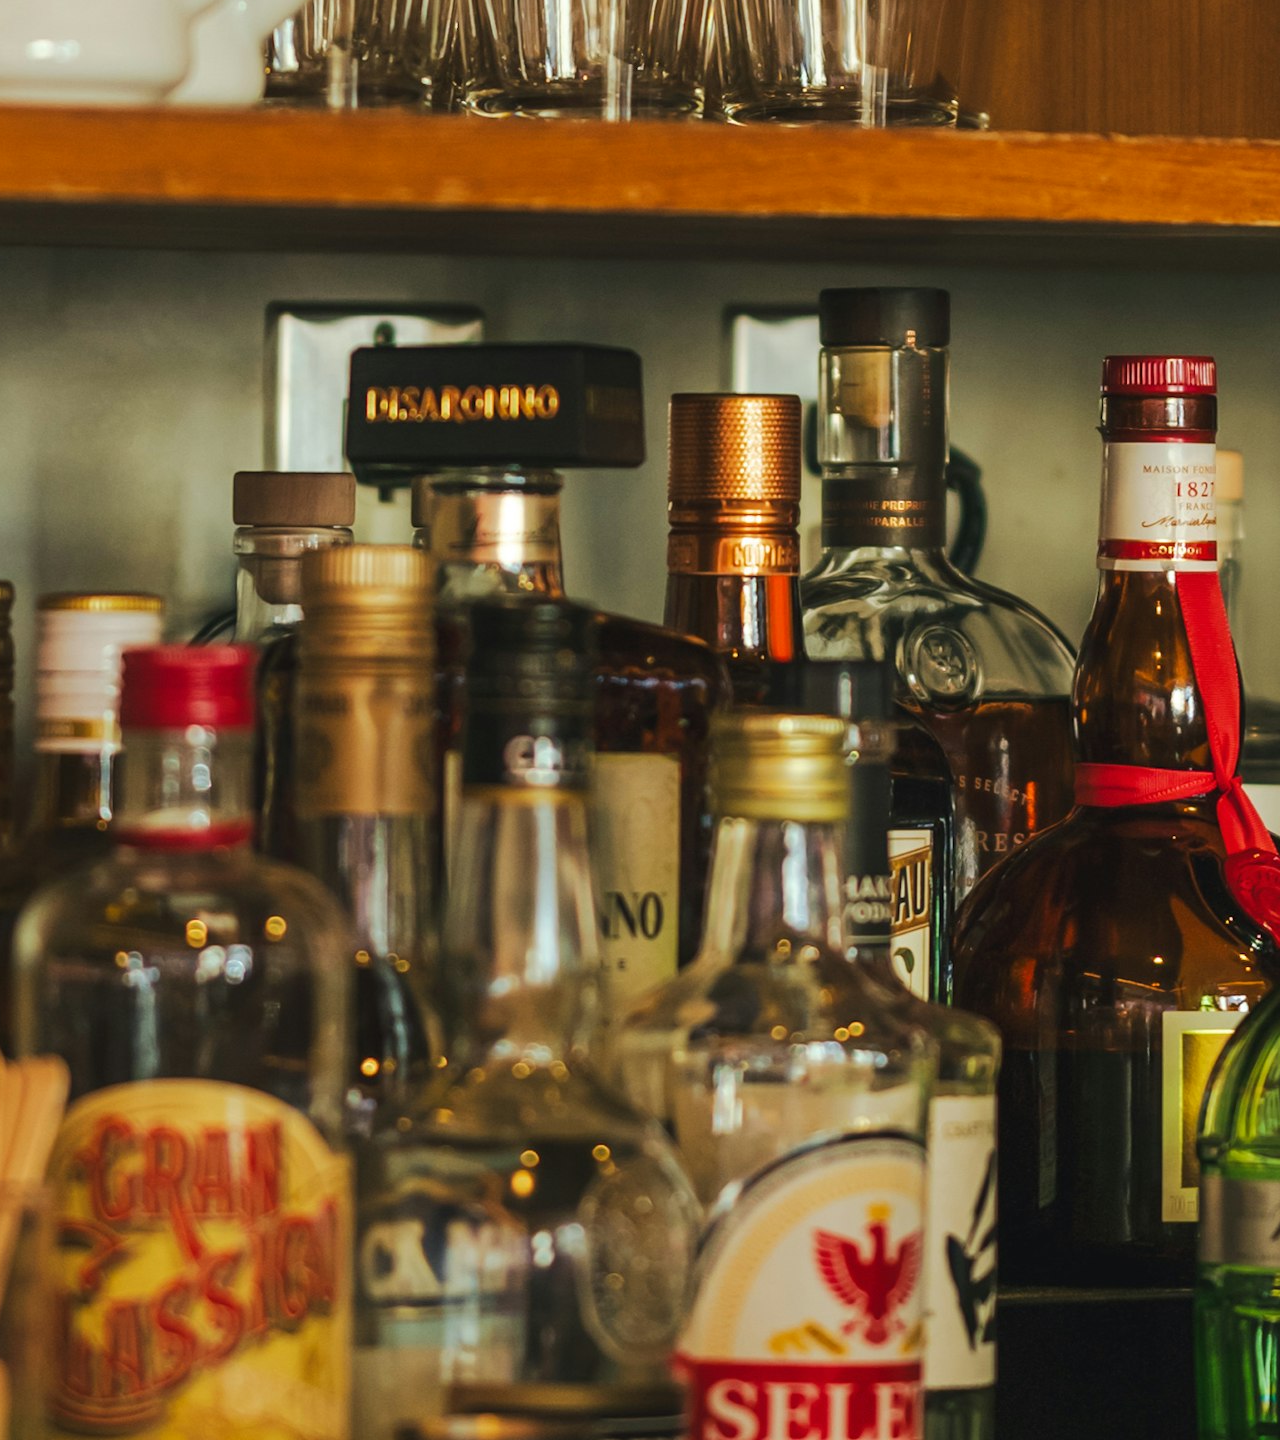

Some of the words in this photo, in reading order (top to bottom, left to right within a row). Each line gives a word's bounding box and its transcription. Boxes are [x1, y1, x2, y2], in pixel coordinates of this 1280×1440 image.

[365, 384, 561, 421] DISARONNO
[1143, 465, 1189, 474] MAISON
[976, 831, 1035, 853] RES
[891, 859, 929, 926] AU
